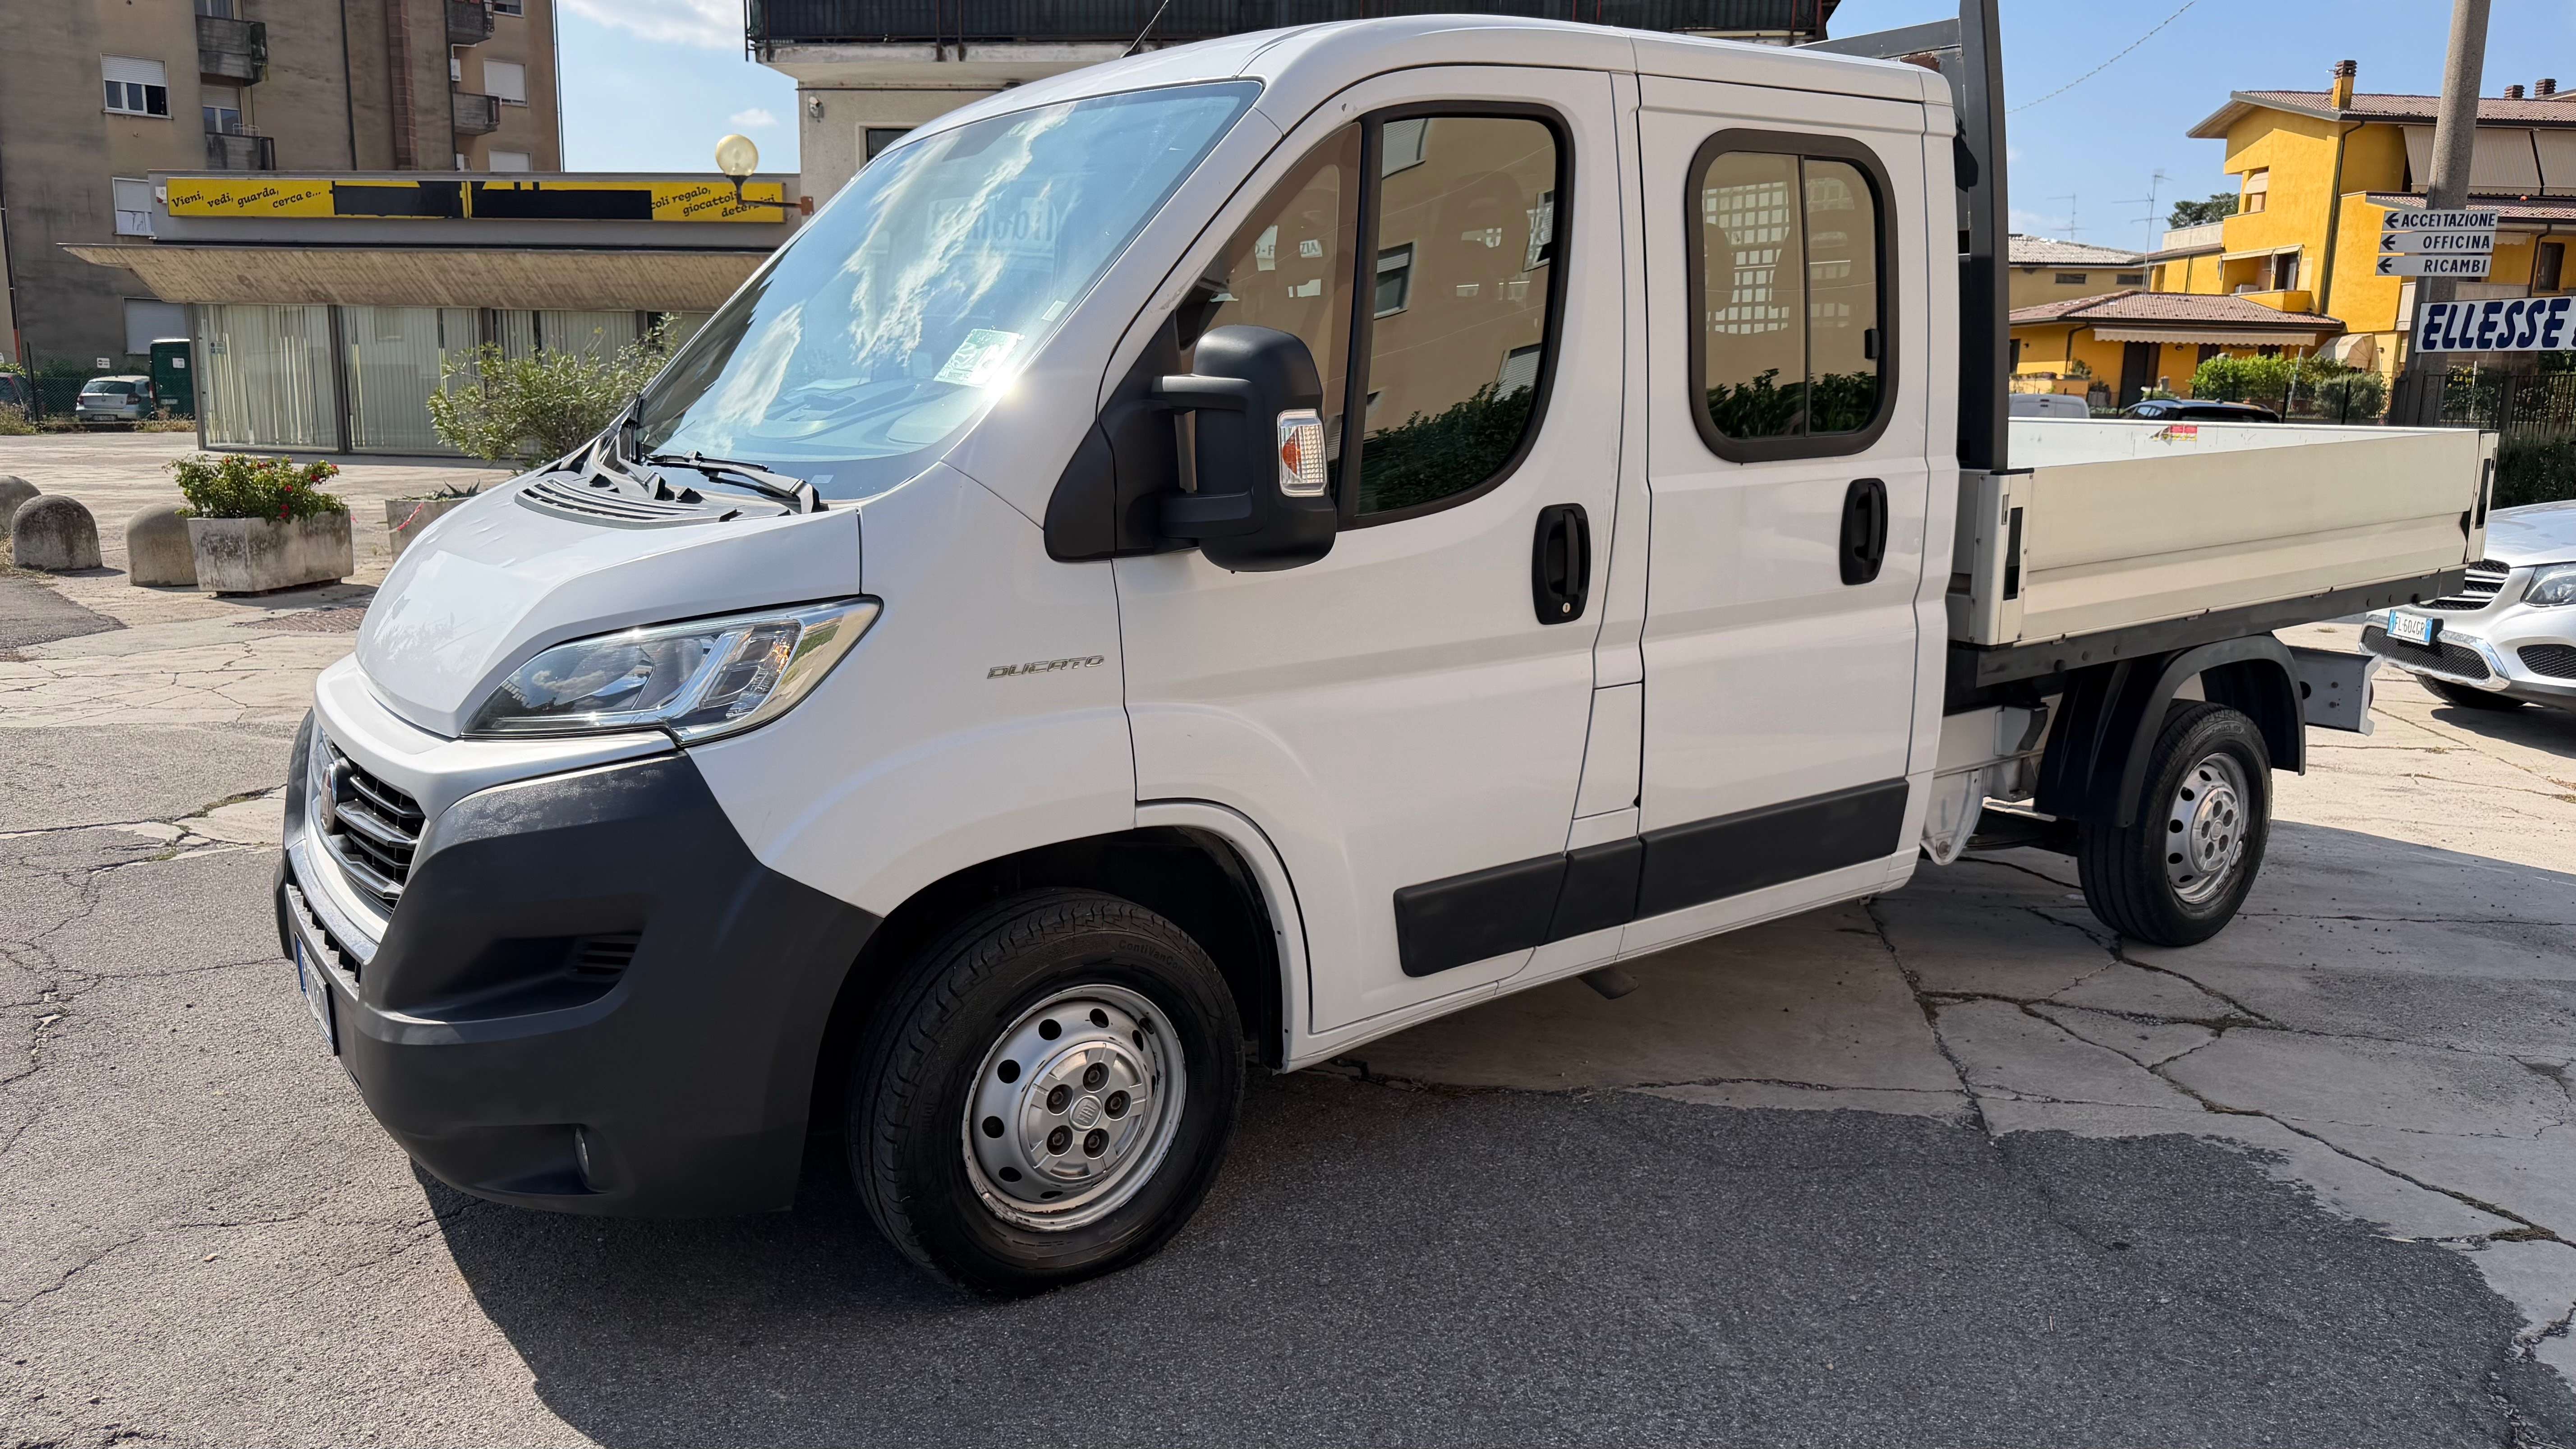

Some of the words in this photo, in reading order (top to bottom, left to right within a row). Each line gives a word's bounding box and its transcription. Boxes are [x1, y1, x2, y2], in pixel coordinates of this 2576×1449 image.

[171, 191, 204, 207] Vieni,
[207, 193, 234, 207] vedi,
[238, 187, 279, 207] guarda,
[272, 193, 304, 208] cerca
[306, 190, 321, 198] e...
[672, 186, 711, 204] regalo,
[2401, 213, 2496, 227] ACCETTAZIONE
[2423, 235, 2490, 249] OFFICINA
[2424, 259, 2487, 272] RICAMBI
[2422, 298, 2571, 350] ELLESSE
[987, 655, 1104, 679] DUCATO
[1076, 1101, 1096, 1123] FIAT
